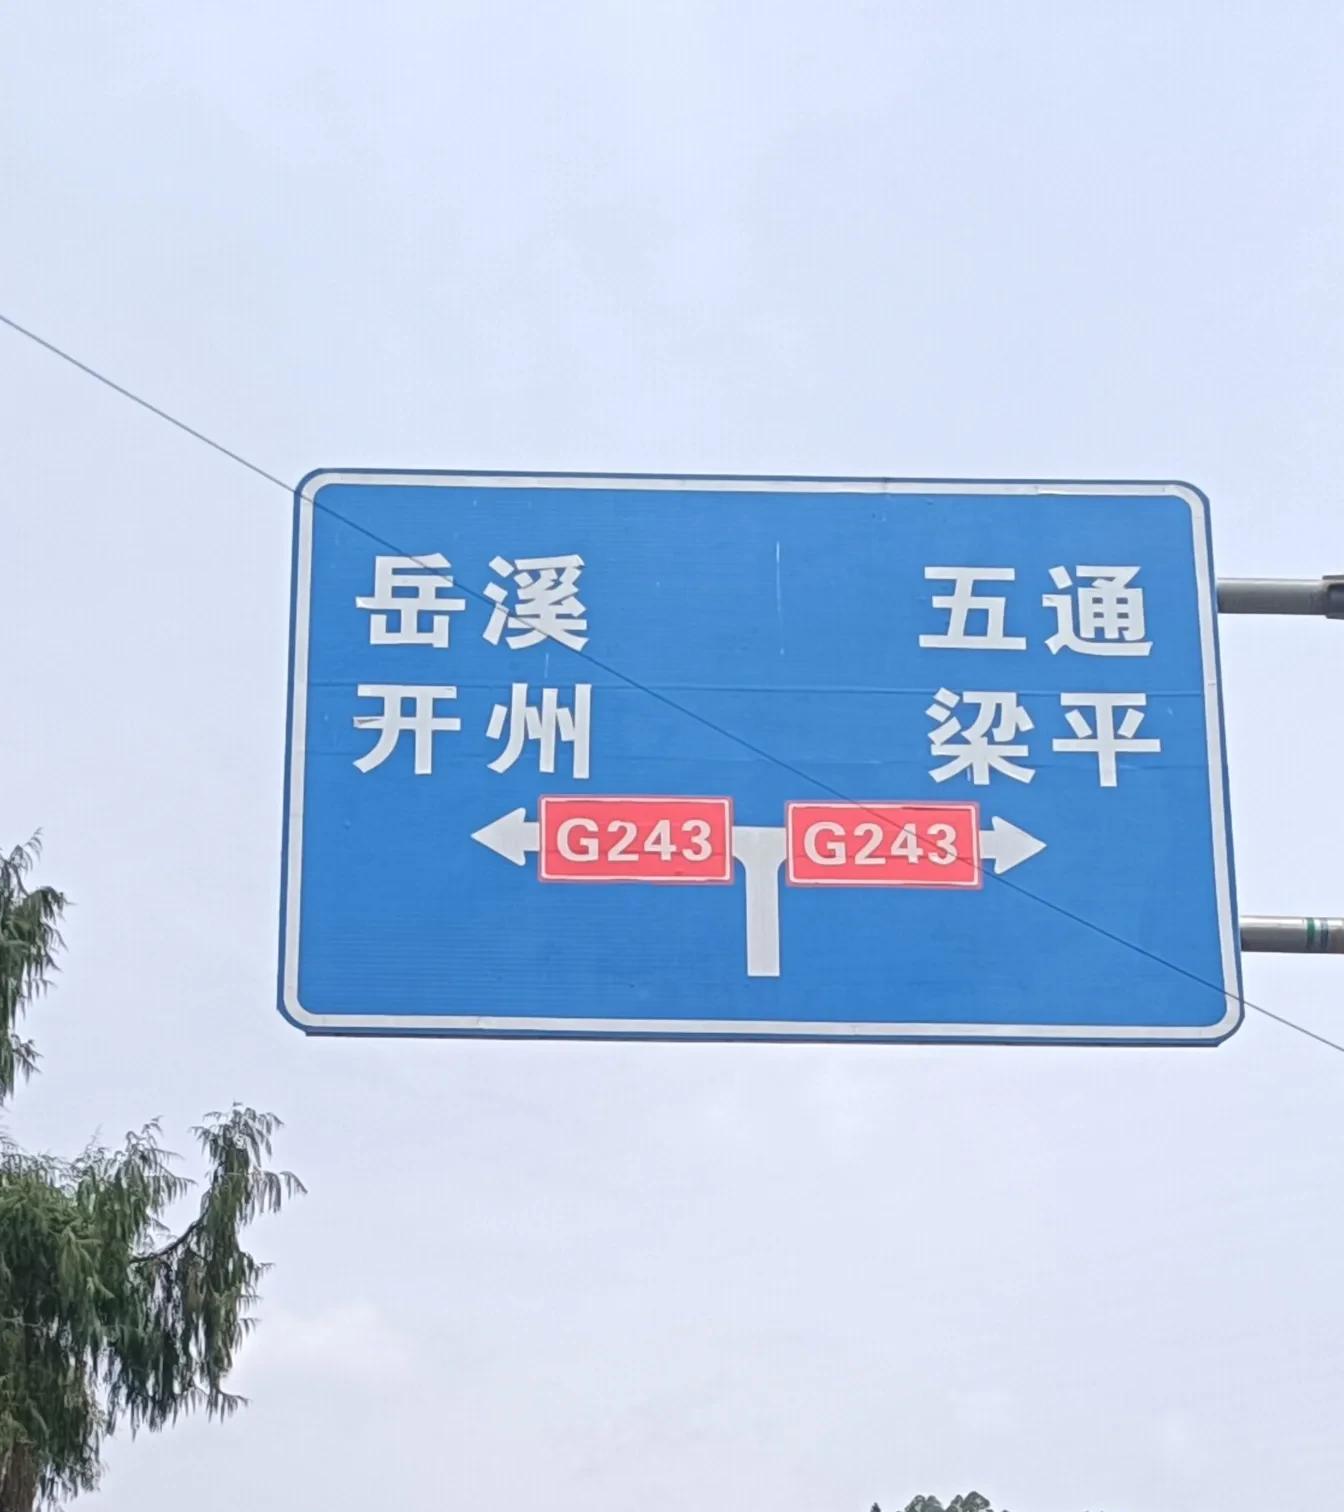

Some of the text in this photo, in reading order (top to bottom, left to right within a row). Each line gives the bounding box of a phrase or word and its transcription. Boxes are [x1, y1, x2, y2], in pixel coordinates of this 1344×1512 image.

[354, 551, 591, 652] 岳溪
[918, 564, 1154, 657] 五通
[352, 682, 593, 779] 开州
[926, 688, 1162, 787] 梁平
[555, 818, 714, 864] G243
[802, 822, 958, 867] G243
